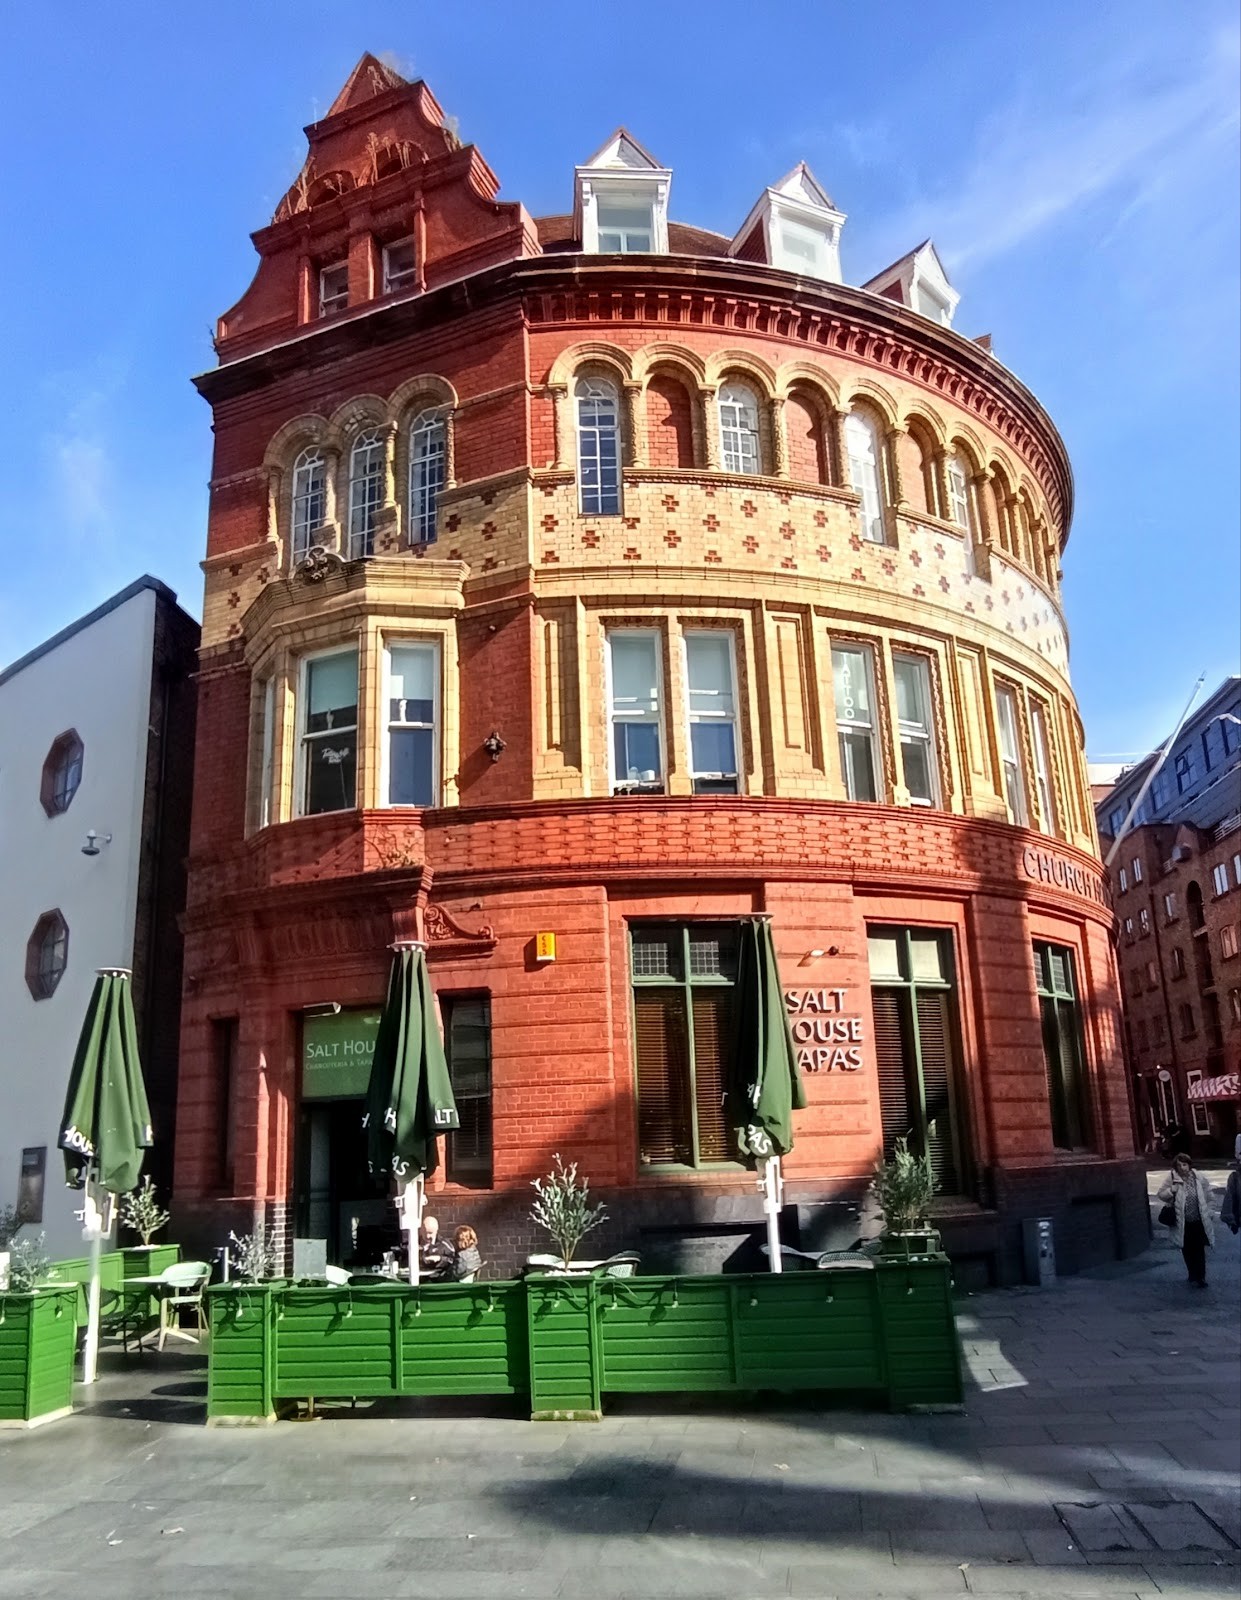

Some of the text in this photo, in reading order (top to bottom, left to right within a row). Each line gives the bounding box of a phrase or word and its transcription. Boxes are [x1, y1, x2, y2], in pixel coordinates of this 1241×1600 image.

[1022, 847, 1092, 899] CHURCH
[785, 987, 848, 1014] SALT
[791, 1017, 864, 1044] OUSE
[306, 1040, 376, 1059] SALT HOU
[797, 1046, 863, 1072] APAS
